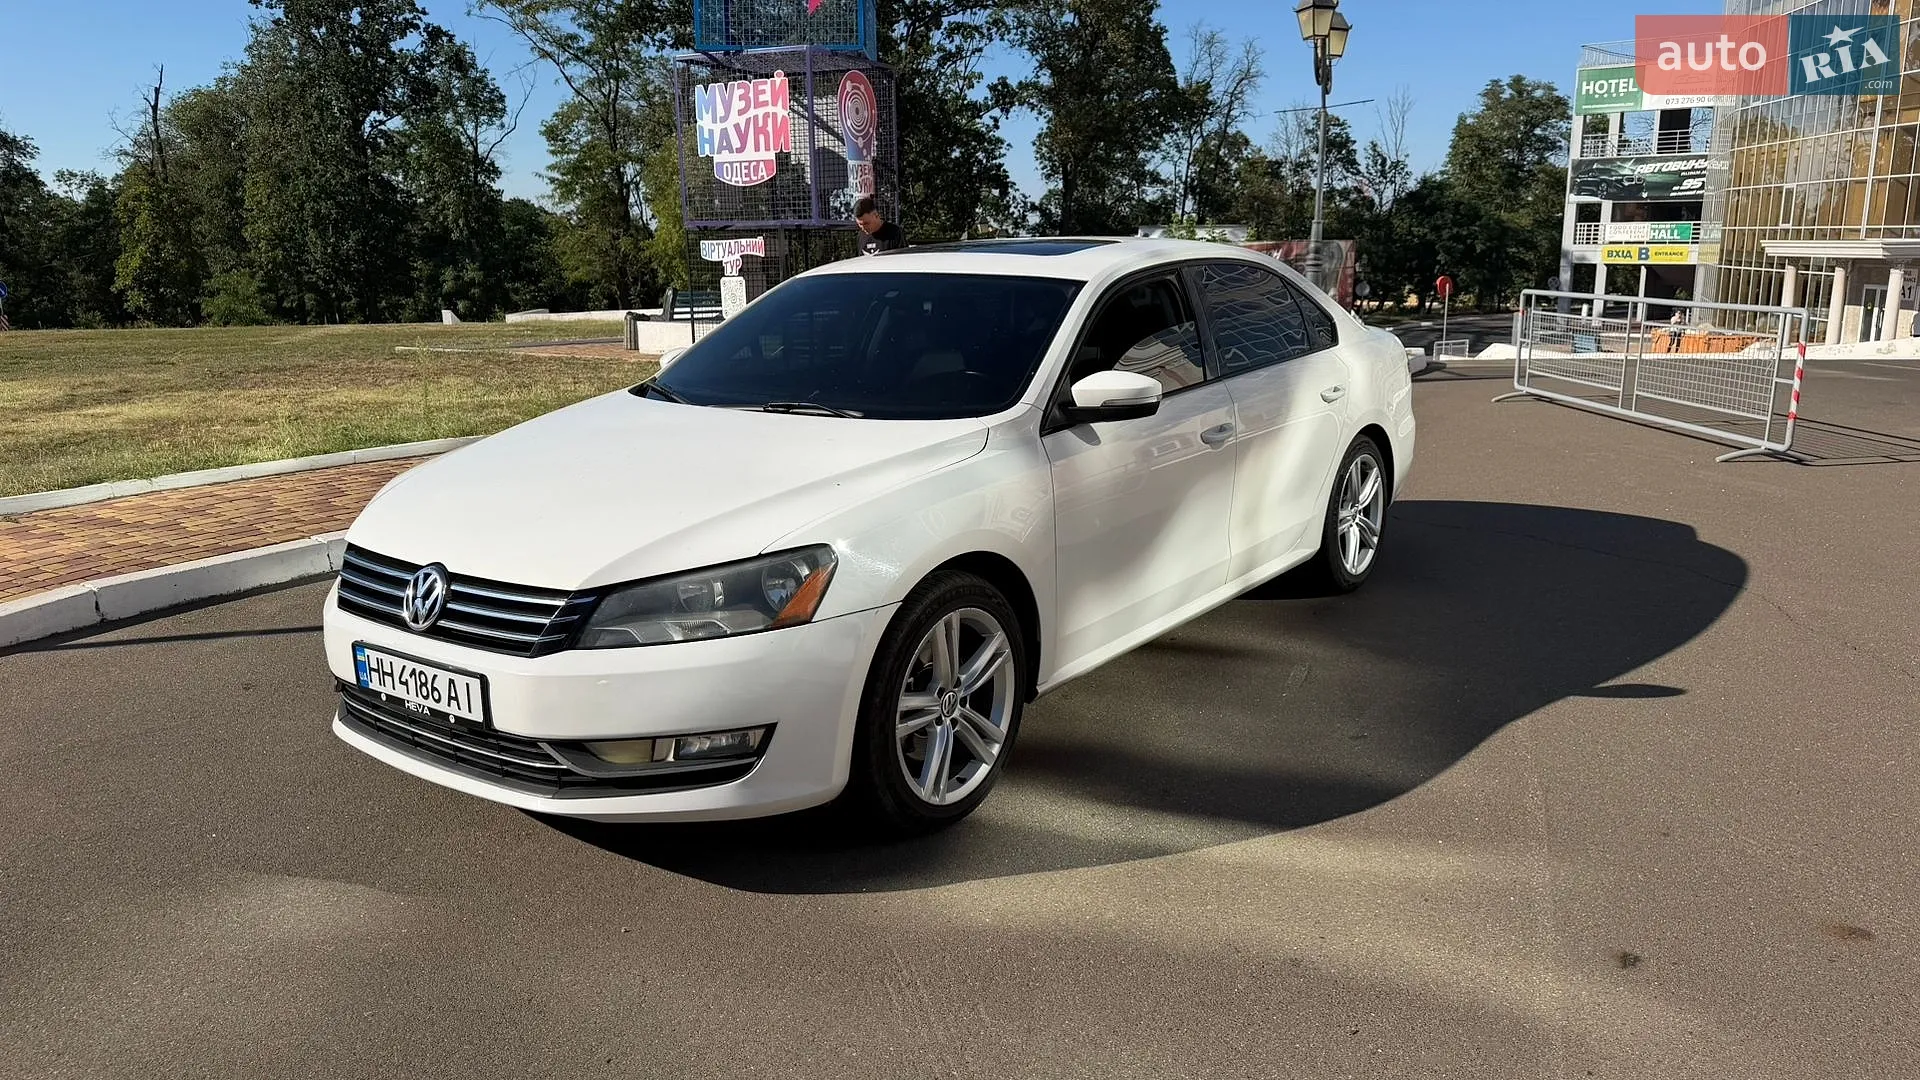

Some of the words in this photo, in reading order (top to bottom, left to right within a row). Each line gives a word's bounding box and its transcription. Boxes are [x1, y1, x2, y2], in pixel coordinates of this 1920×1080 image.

[1581, 77, 1638, 95] HOTEL
[695, 70, 789, 124] МУЗЕЙ
[1665, 97, 1679, 105] 073
[697, 112, 791, 156] НАУКИ
[723, 161, 767, 184] ОДЕСА
[1650, 229, 1680, 239] HALL
[701, 237, 764, 258] ВІРТУАЛЬНИЙ
[1607, 250, 1633, 259] ВХІД
[723, 258, 742, 275] ТУР
[366, 654, 396, 691] HH
[398, 664, 442, 704] 4186
[446, 677, 472, 714] AI
